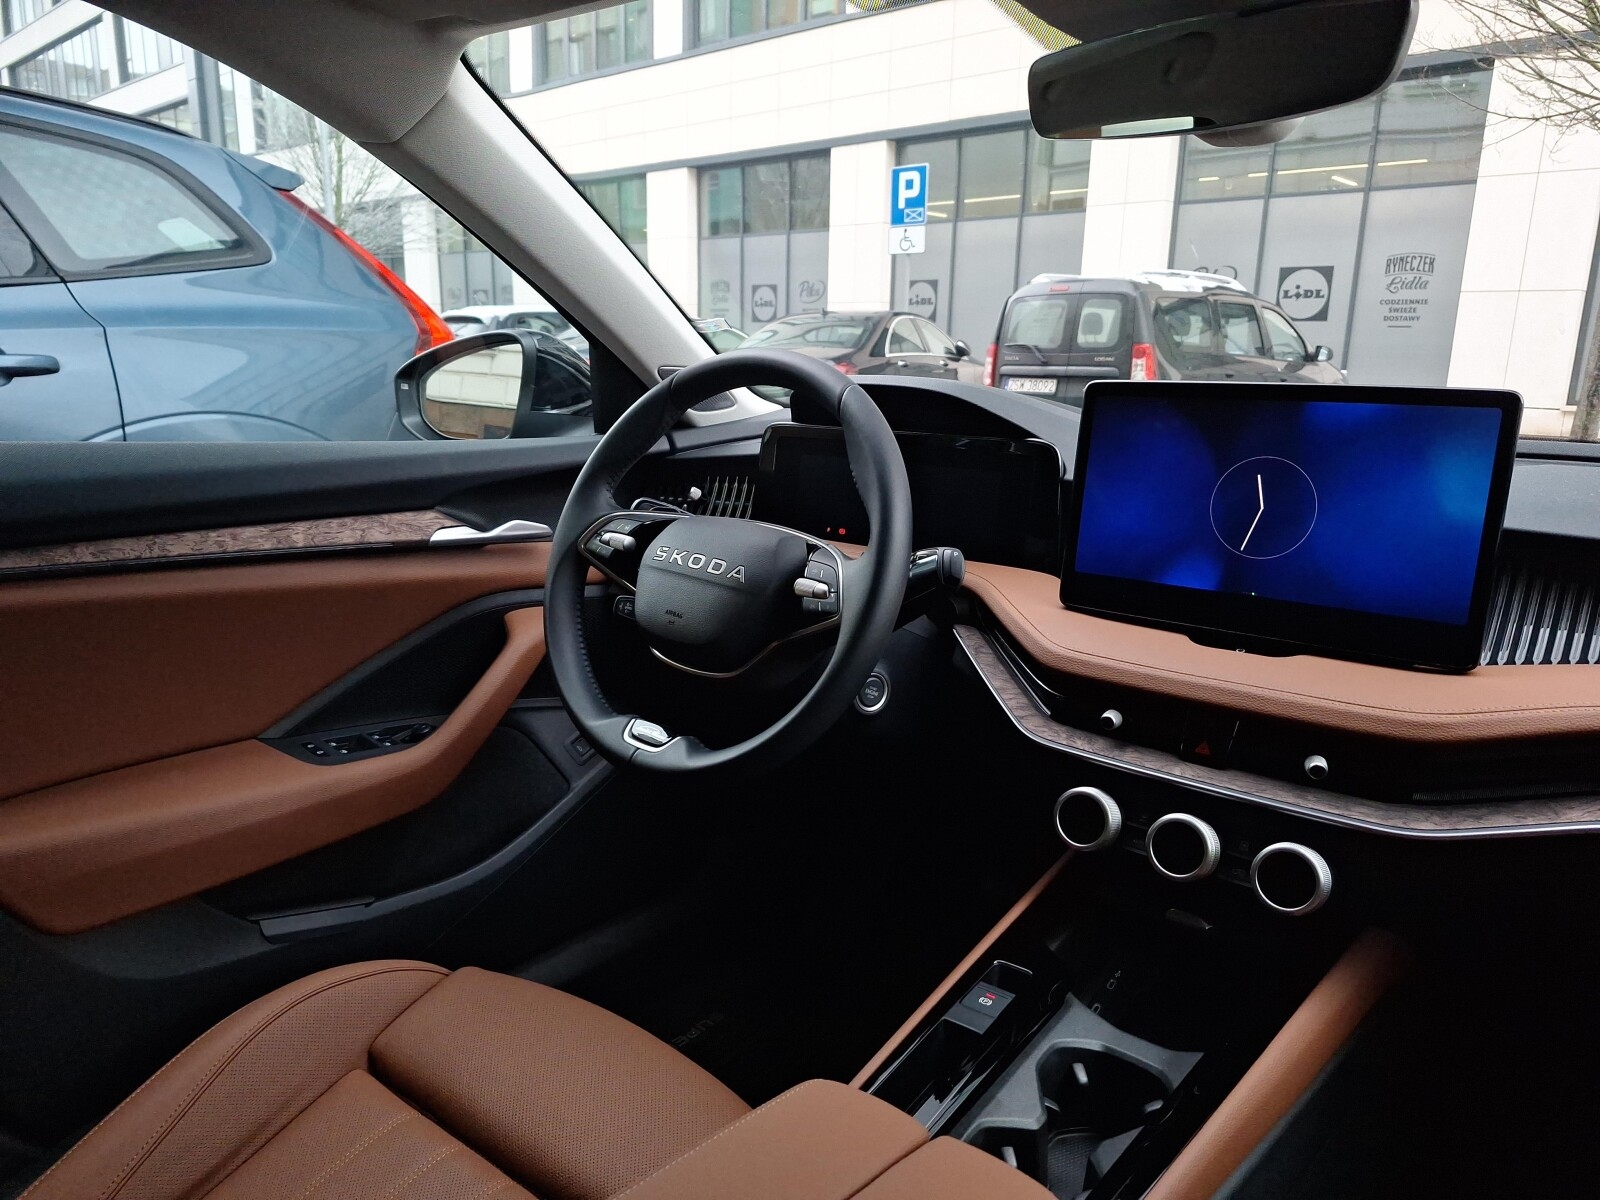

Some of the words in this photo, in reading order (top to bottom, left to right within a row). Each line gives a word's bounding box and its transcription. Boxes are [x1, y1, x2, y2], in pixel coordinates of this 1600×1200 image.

[898, 170, 921, 210] P
[1385, 255, 1436, 274] RYNECZEK
[1385, 276, 1429, 294] Lidla
[1388, 306, 1417, 314] ŚWIEŻE
[1027, 379, 1055, 392] 38092
